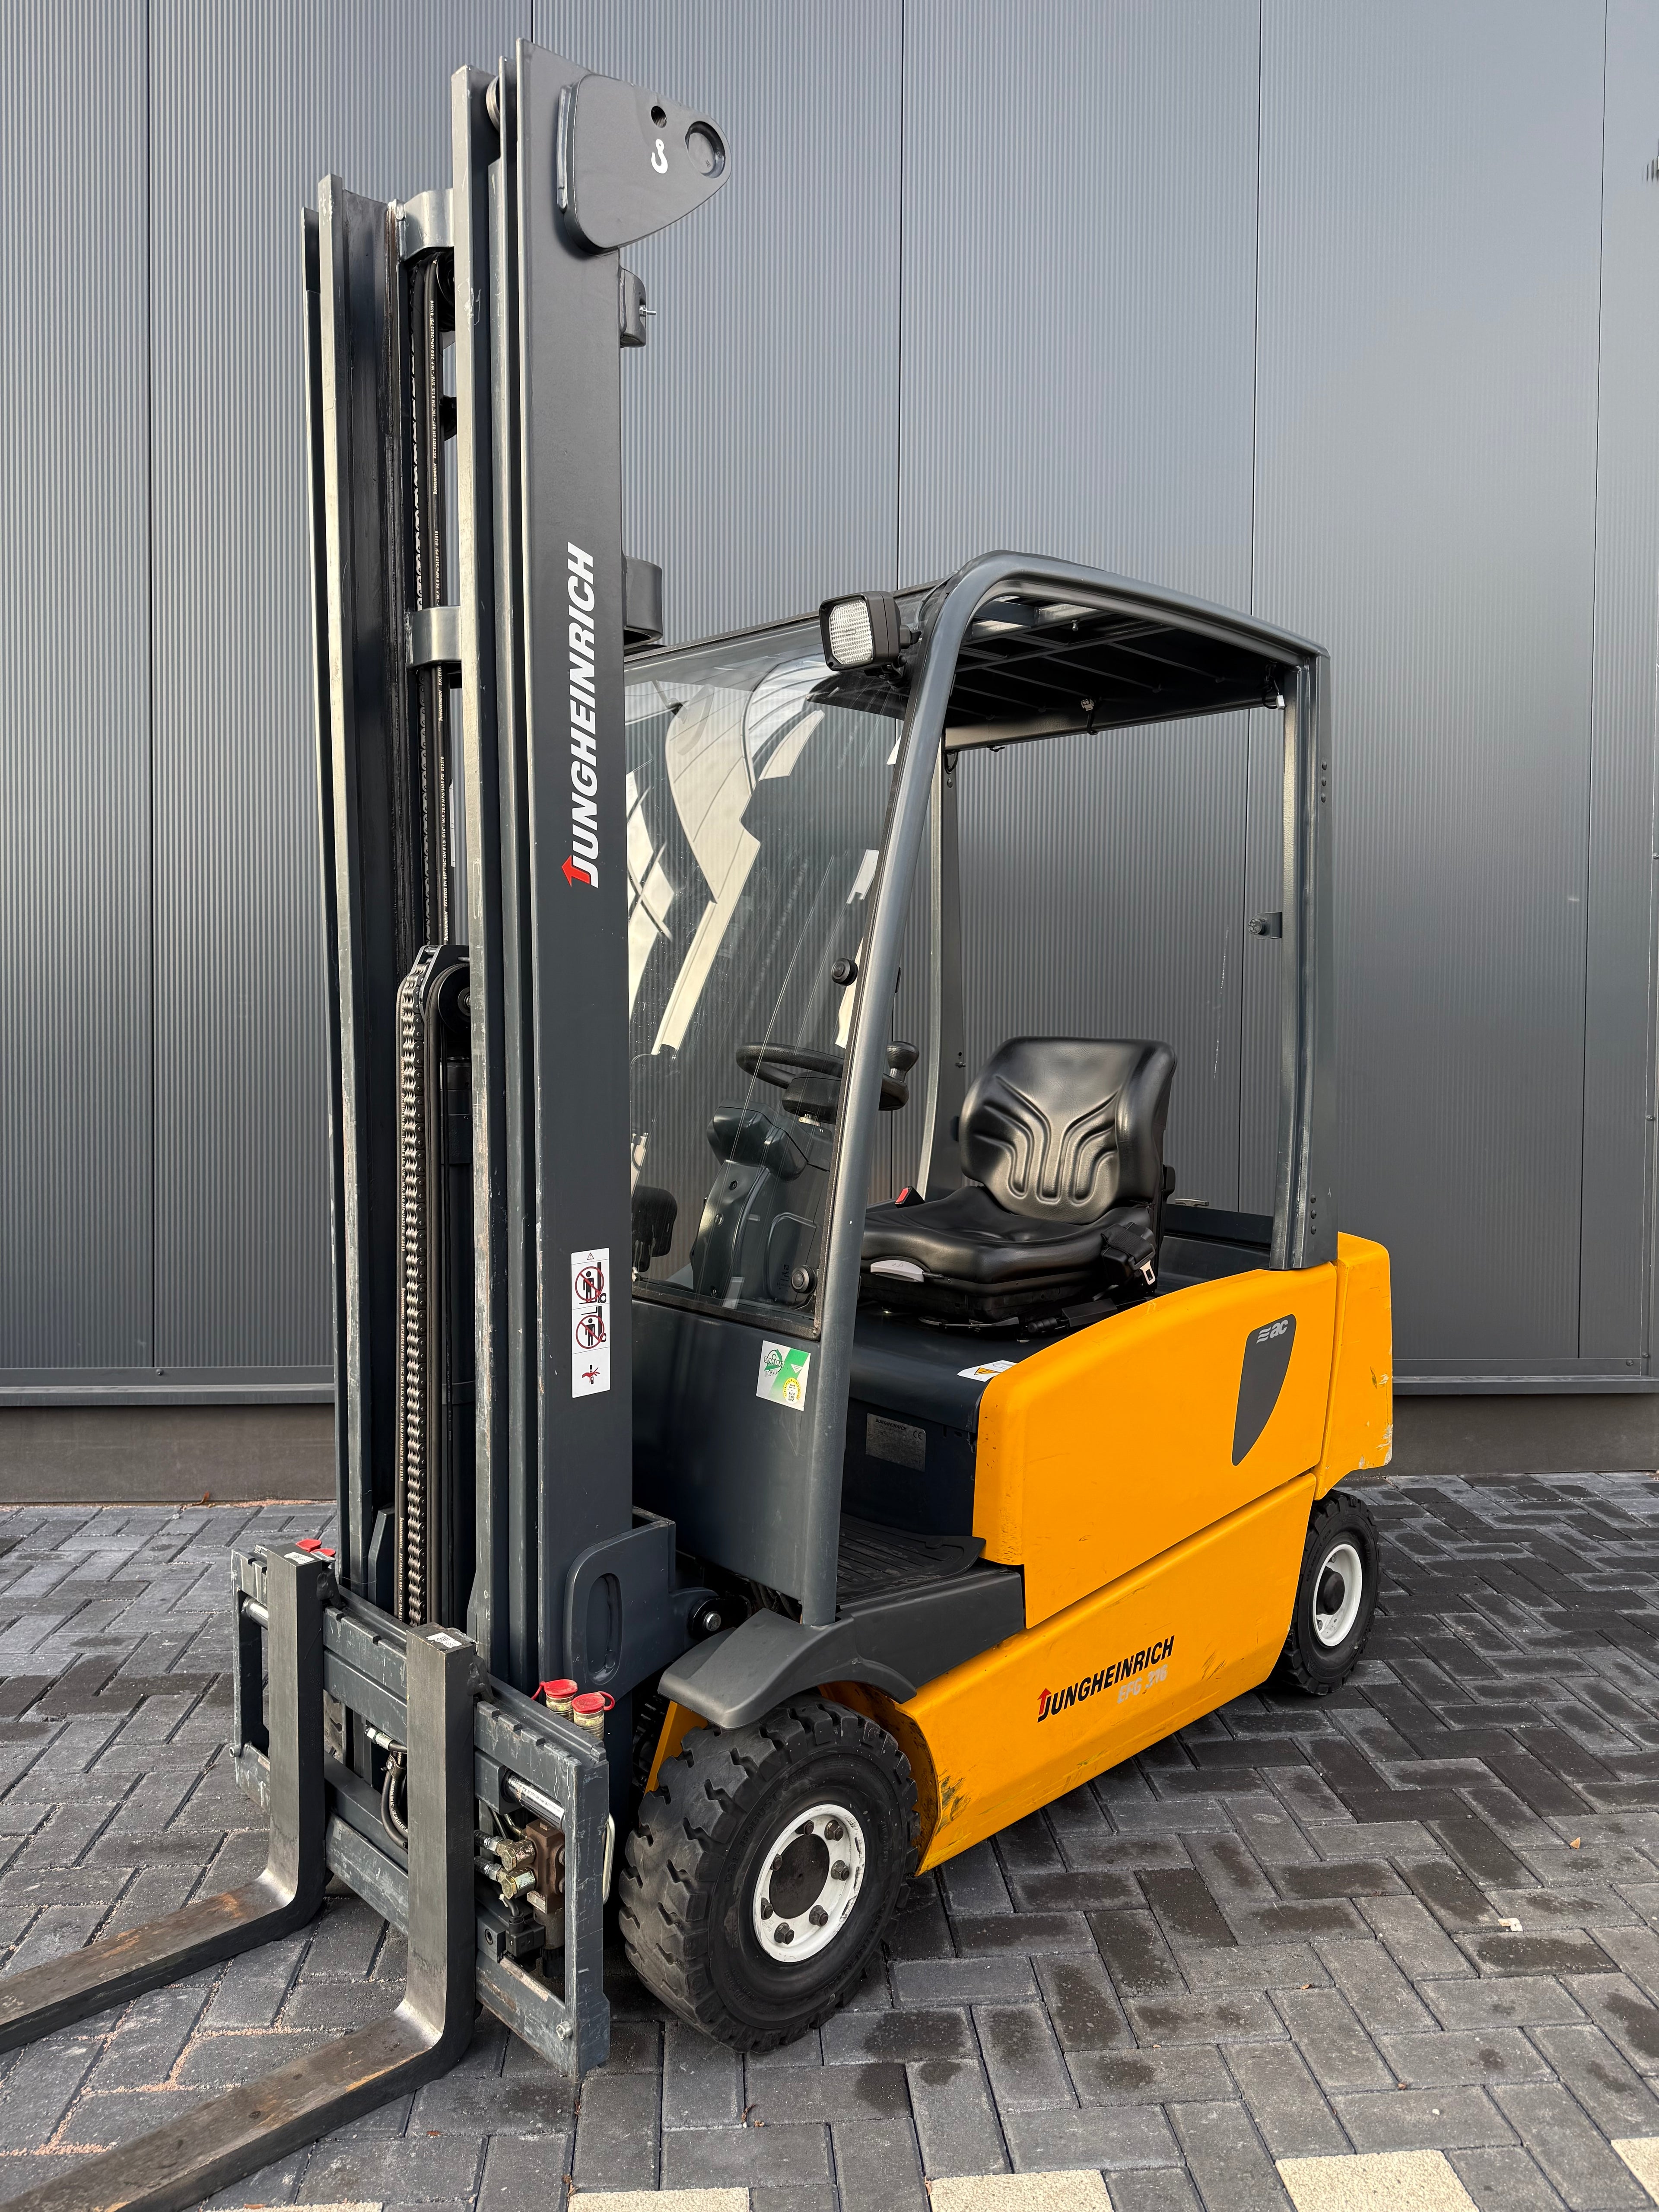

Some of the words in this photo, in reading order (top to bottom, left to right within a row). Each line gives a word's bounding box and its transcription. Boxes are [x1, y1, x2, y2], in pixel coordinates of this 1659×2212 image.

[562, 541, 599, 889] JUNGHEINRICH
[875, 1418, 907, 1430] JUNGHEINRICH
[1037, 1635, 1175, 1723] JUNGHEINRICH
[1117, 1677, 1142, 1704] EFG
